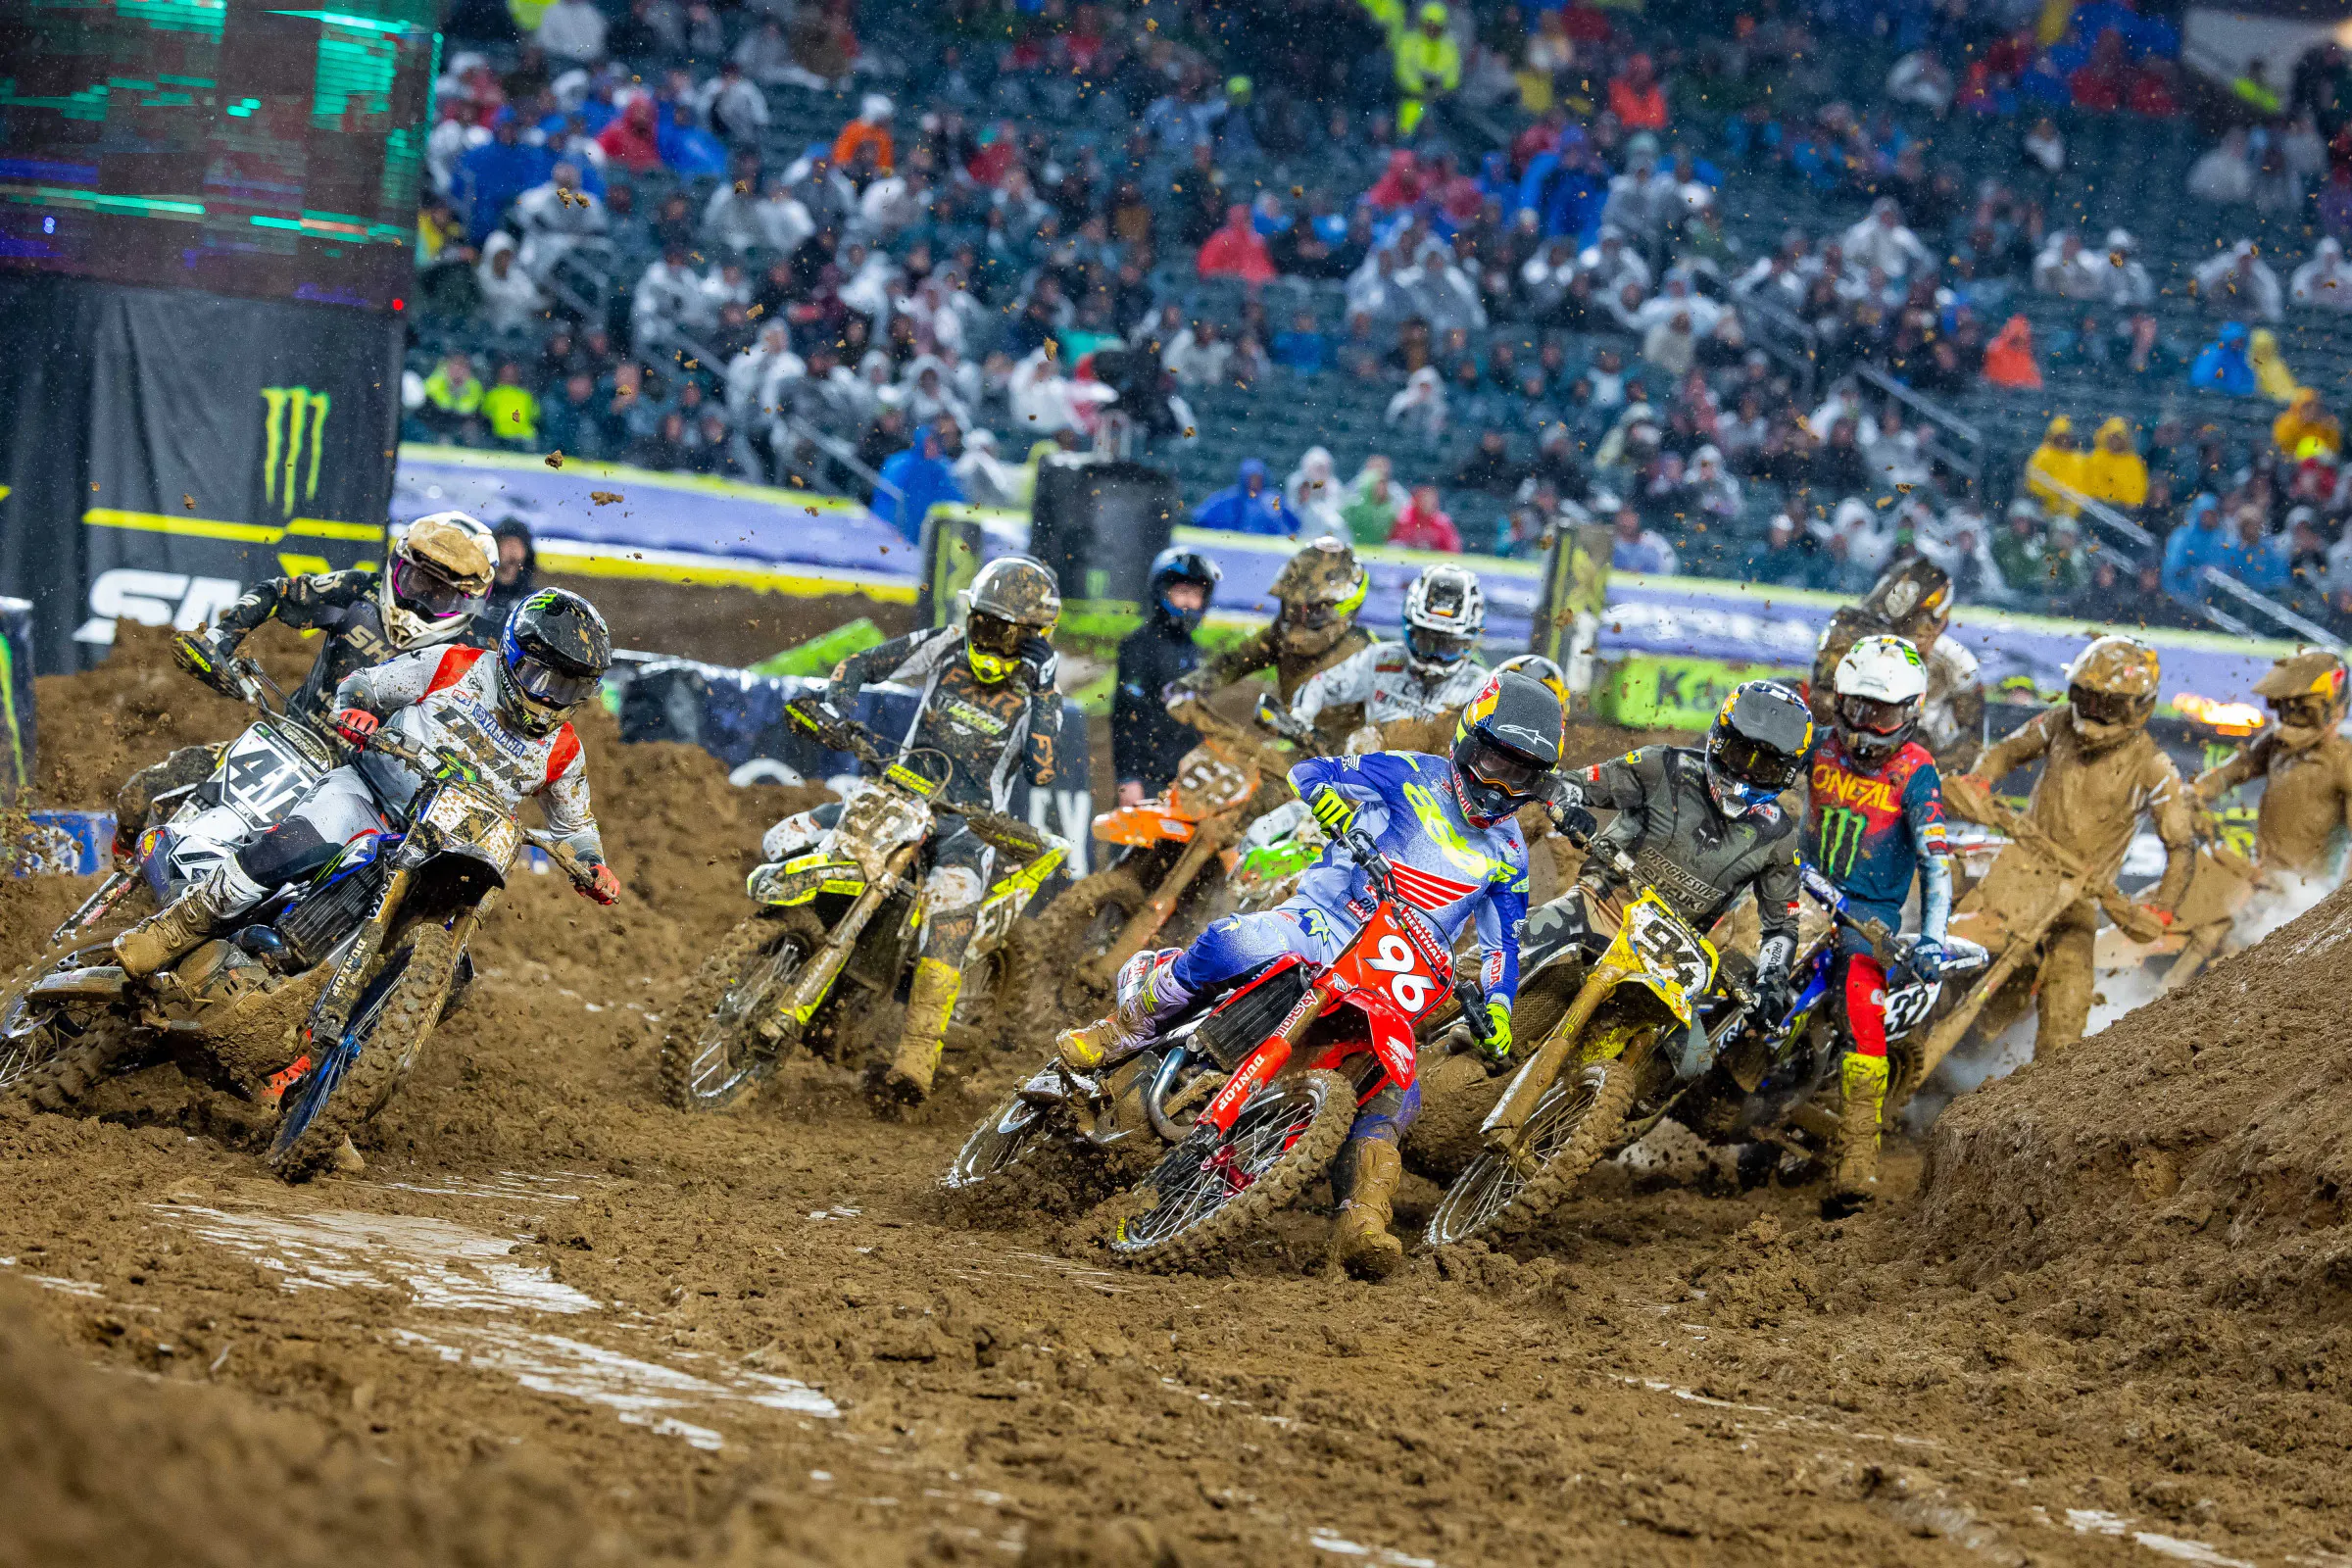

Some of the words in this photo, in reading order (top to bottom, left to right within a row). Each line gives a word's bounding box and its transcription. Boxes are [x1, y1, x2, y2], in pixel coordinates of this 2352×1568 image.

[483, 715, 524, 758] YAMAHA
[1642, 847, 1727, 901] PROGRESSIVE
[1402, 911, 1442, 965] RENTHAL
[1642, 919, 1700, 987] 94
[331, 938, 368, 998] DUNLOP
[1363, 934, 1437, 1013] 96
[1273, 1004, 1306, 1040] SHOW
[1218, 1054, 1266, 1112] DUNLOP
